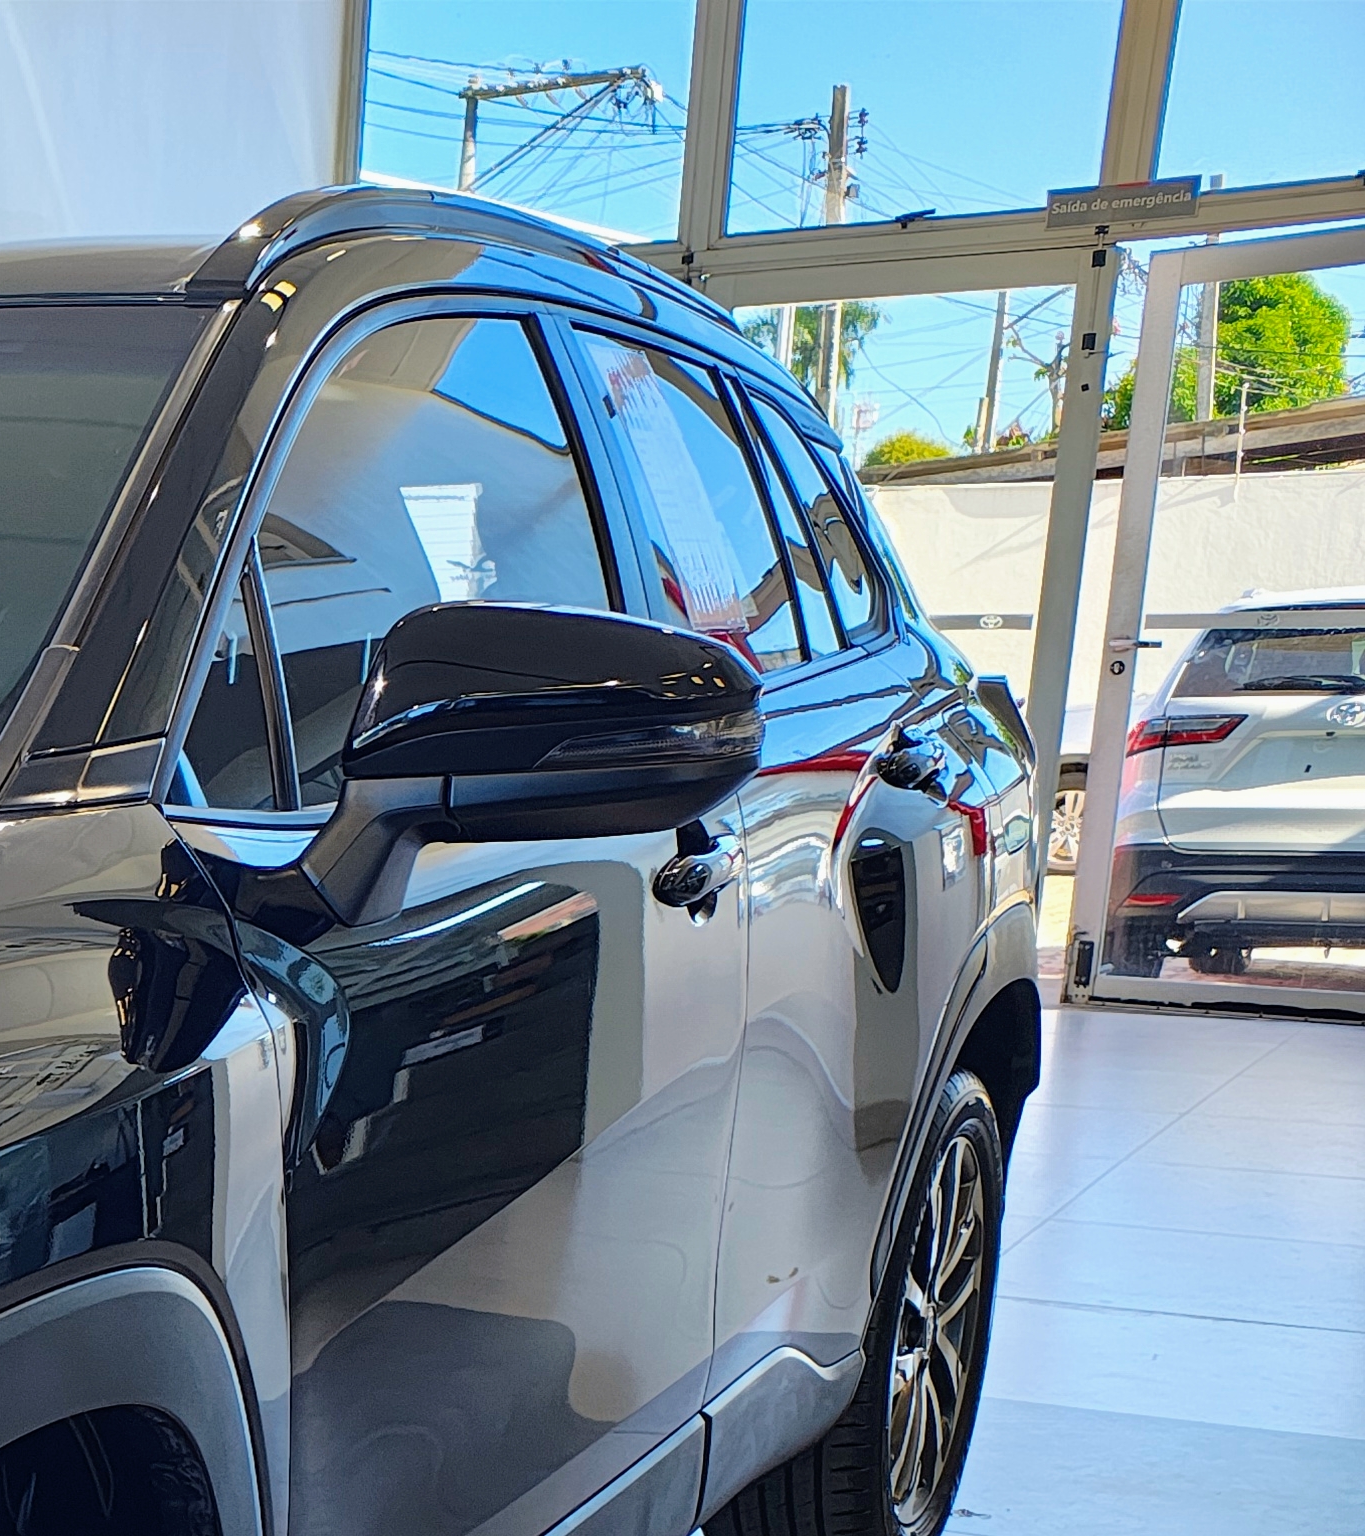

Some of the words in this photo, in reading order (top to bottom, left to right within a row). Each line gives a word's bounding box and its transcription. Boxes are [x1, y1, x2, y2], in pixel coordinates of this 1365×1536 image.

[1052, 200, 1087, 215] Saída
[1091, 199, 1108, 212] de
[1112, 190, 1192, 209] emergência
